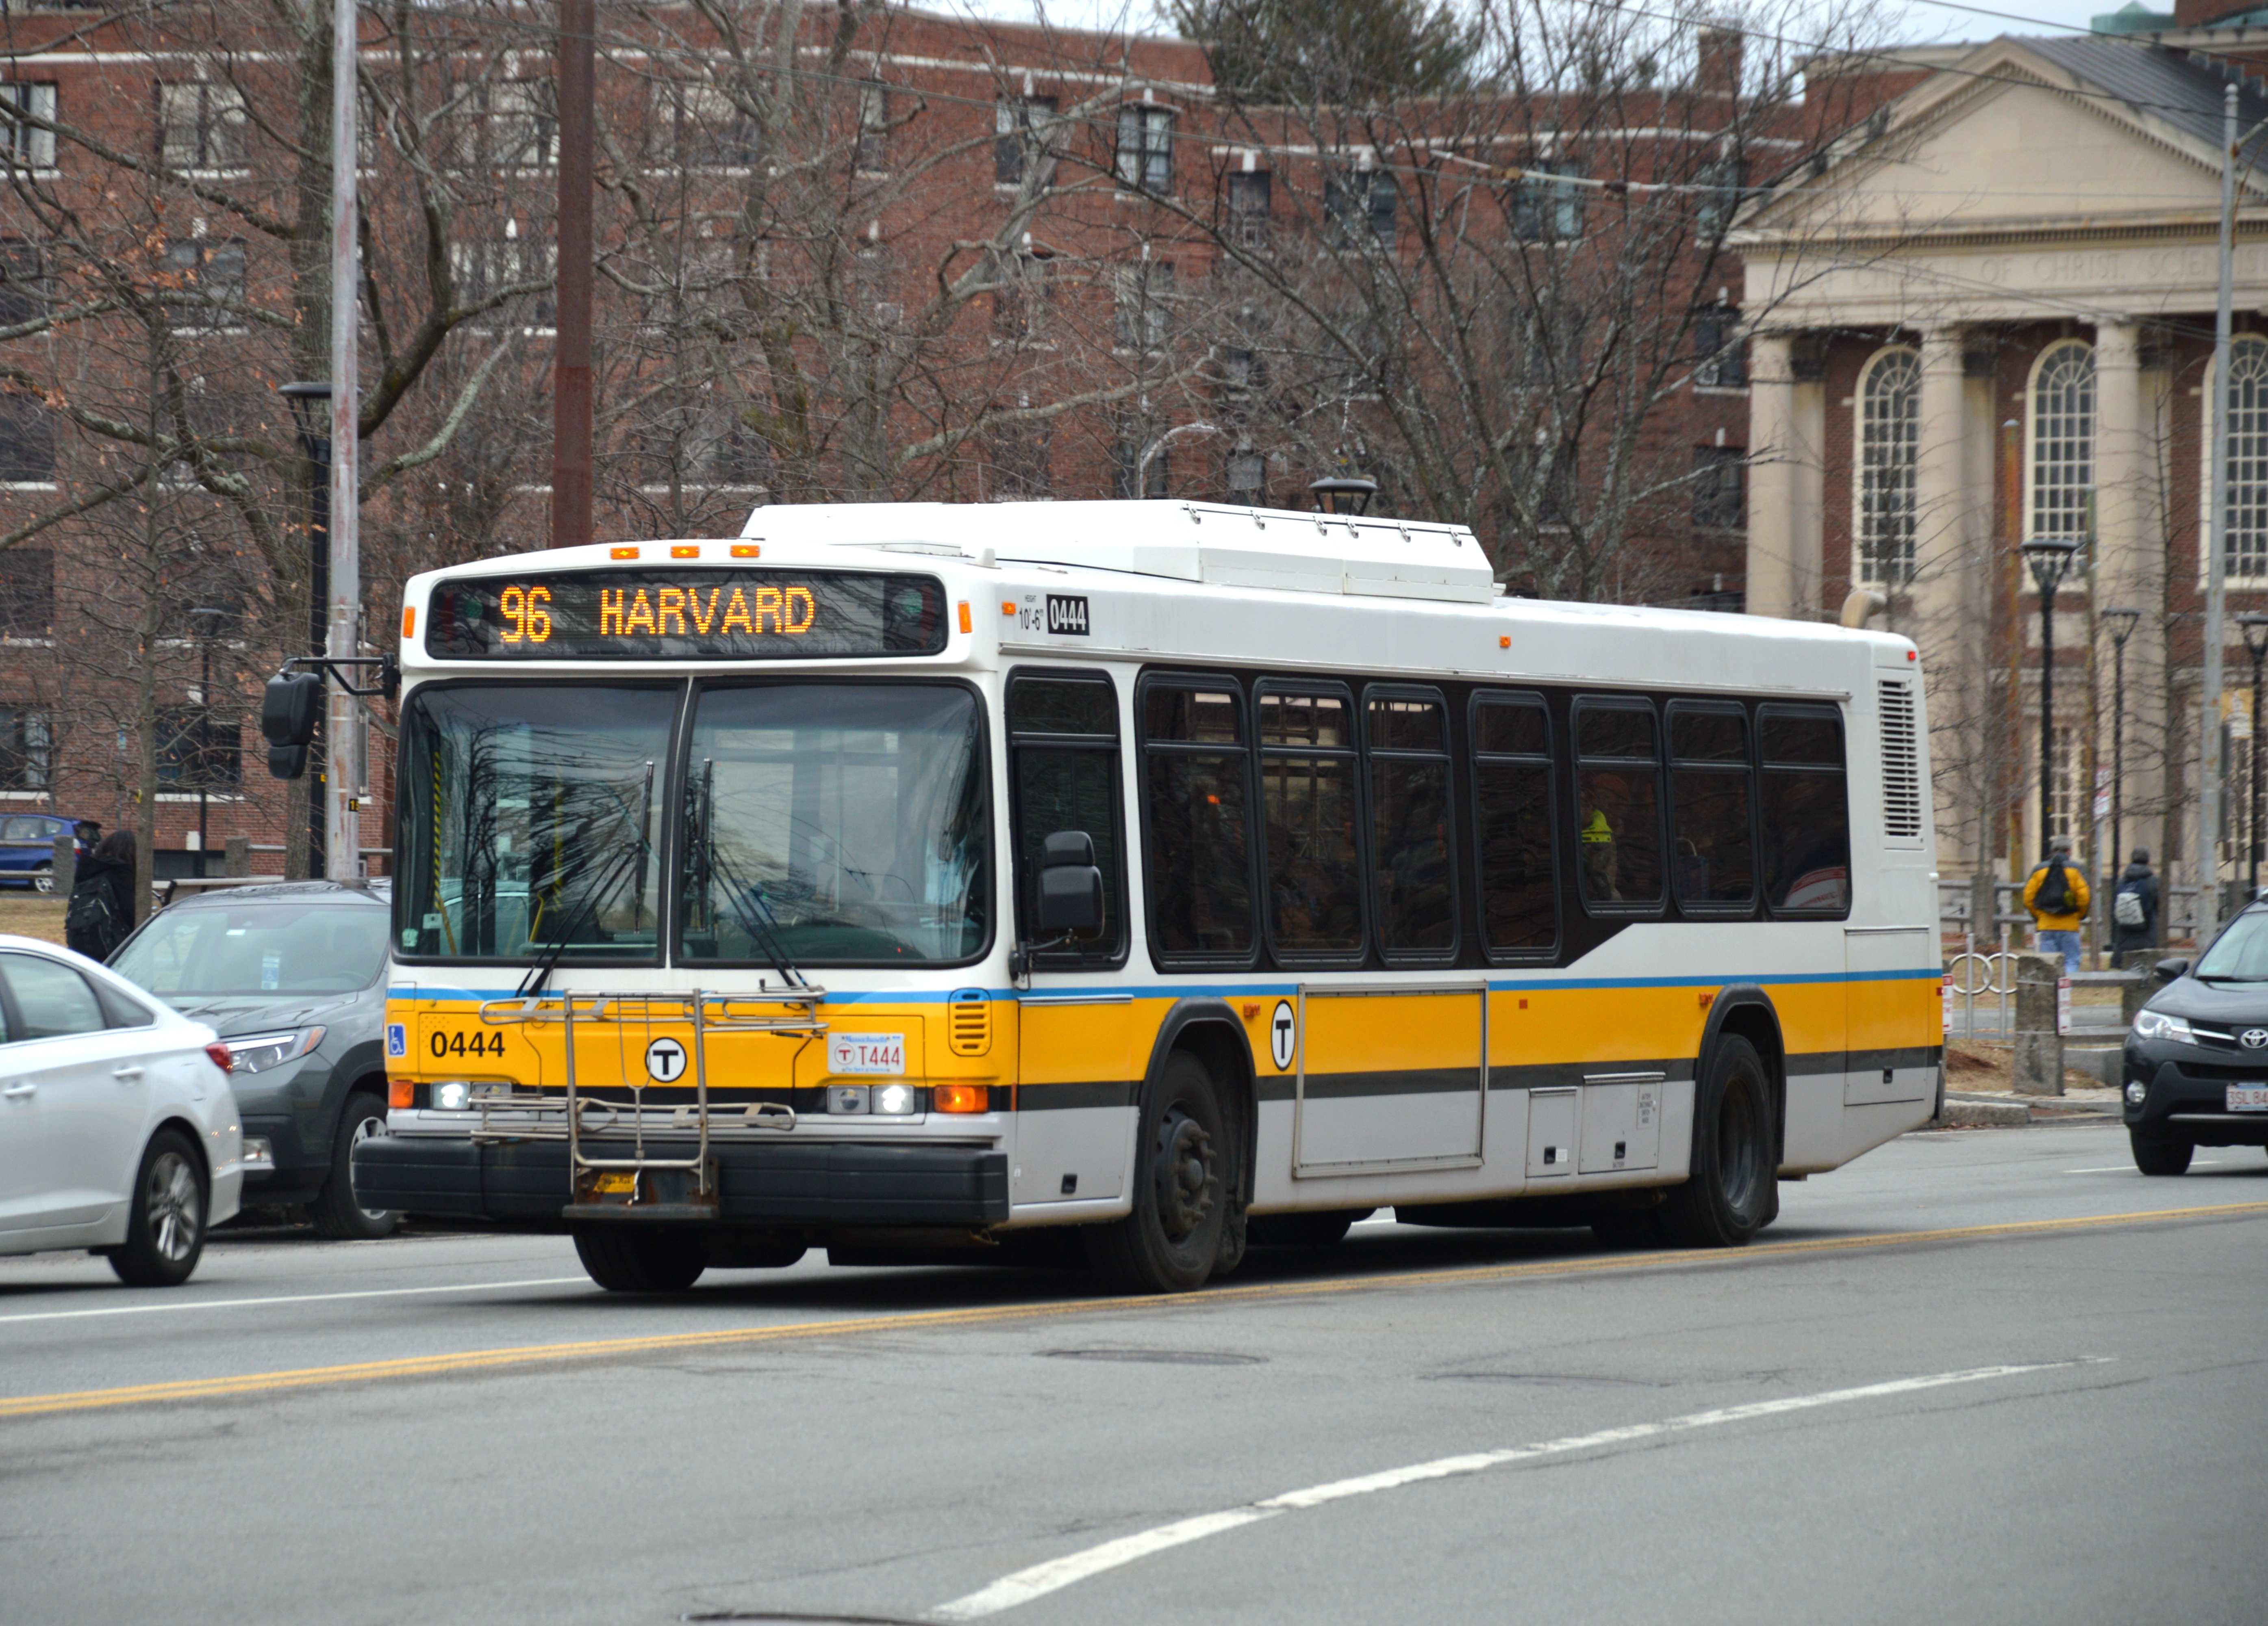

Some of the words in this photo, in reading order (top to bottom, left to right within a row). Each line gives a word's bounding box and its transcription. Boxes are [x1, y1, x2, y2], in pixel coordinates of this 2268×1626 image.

[500, 587, 551, 642] 96
[601, 587, 814, 635] HARVARD
[1050, 598, 1086, 630] 0444
[431, 1030, 505, 1057] 0444
[1275, 1019, 1291, 1059] T
[652, 1050, 678, 1075] T
[858, 1045, 899, 1065] T444
